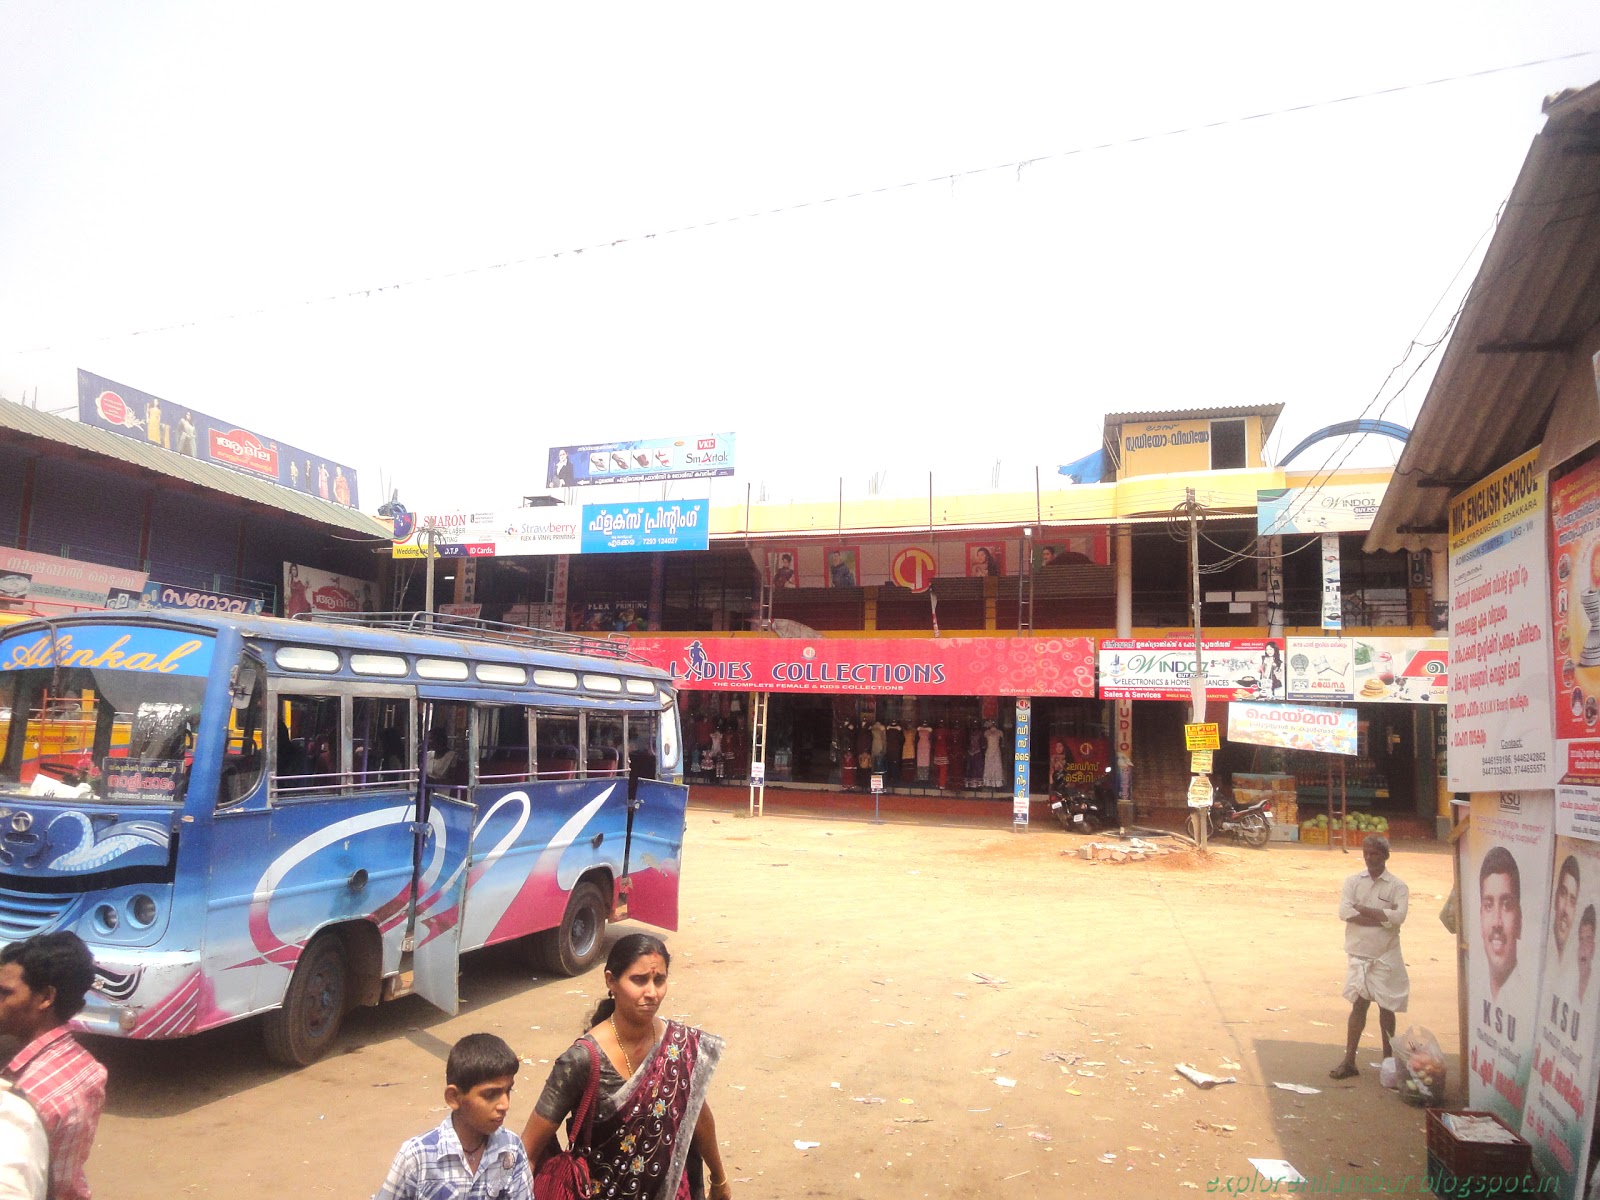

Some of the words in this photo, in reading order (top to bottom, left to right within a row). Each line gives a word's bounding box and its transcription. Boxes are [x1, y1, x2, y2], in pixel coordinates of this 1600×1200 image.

[698, 440, 715, 450] VKC
[1321, 496, 1376, 509] WINDOZ
[1452, 501, 1466, 537] MIC
[1467, 480, 1501, 528] ENGLISH
[1502, 498, 1538, 523] EDAKKARA
[423, 514, 466, 527] SHARON
[521, 523, 577, 535] Strawberry
[396, 547, 419, 556] Wedding
[1127, 652, 1209, 674] WINDOZ
[669, 657, 753, 681] LADIES
[771, 662, 946, 684] COLLECTIONS
[1121, 678, 1163, 687] ELECTRONICS
[1104, 691, 1122, 699] Sales
[1500, 793, 1521, 806] KSU
